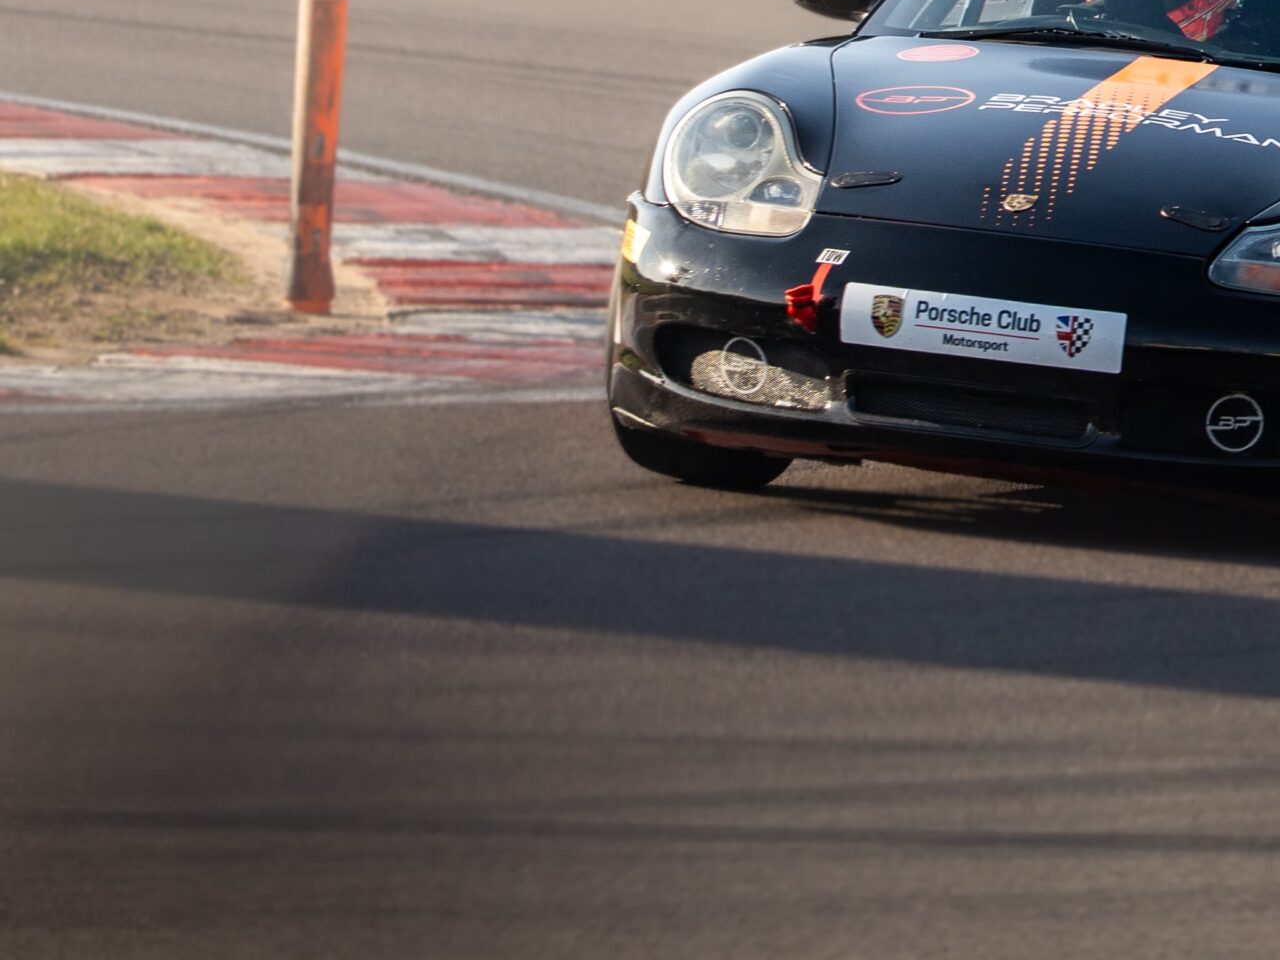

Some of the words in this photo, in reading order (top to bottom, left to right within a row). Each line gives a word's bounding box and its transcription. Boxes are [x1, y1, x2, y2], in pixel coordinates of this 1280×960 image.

[989, 93, 1230, 123] BRADLEY
[819, 249, 848, 263] TOW
[915, 300, 993, 327] Porsche
[997, 309, 1041, 333] Club
[942, 333, 1009, 352] Motorsport
